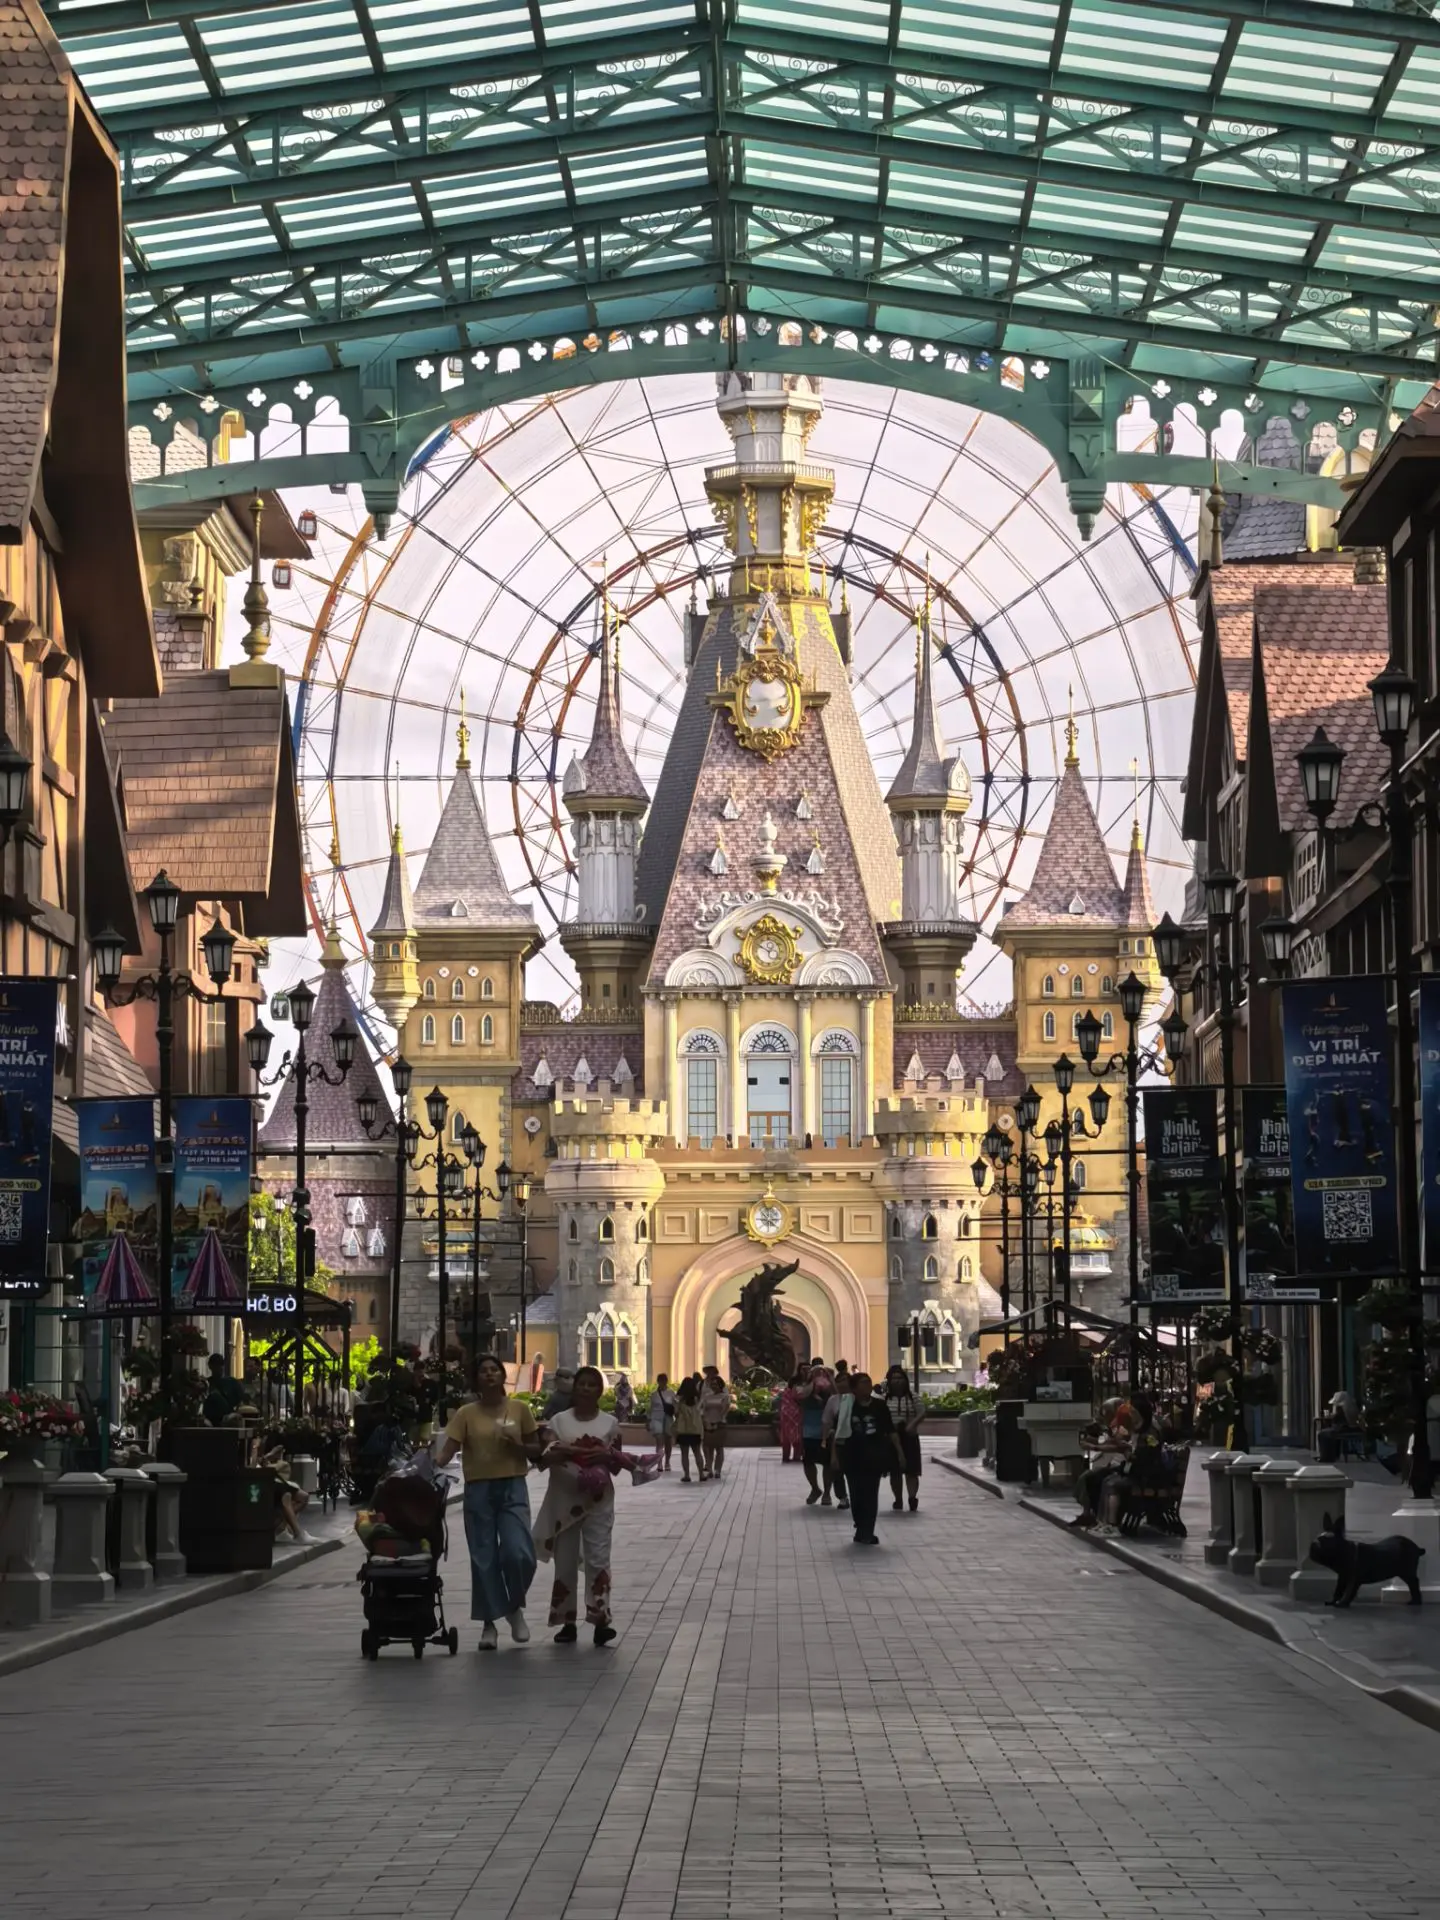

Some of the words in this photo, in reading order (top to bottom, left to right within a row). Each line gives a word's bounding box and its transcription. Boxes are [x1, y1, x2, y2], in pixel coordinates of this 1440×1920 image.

[0, 1036, 28, 1052] TRÍ
[1332, 1034, 1360, 1051] TRÍ
[1332, 1047, 1381, 1065] NHẤT
[1162, 1117, 1200, 1140] Night
[246, 1294, 269, 1311] HỞ
[273, 1294, 297, 1312] BÒ
